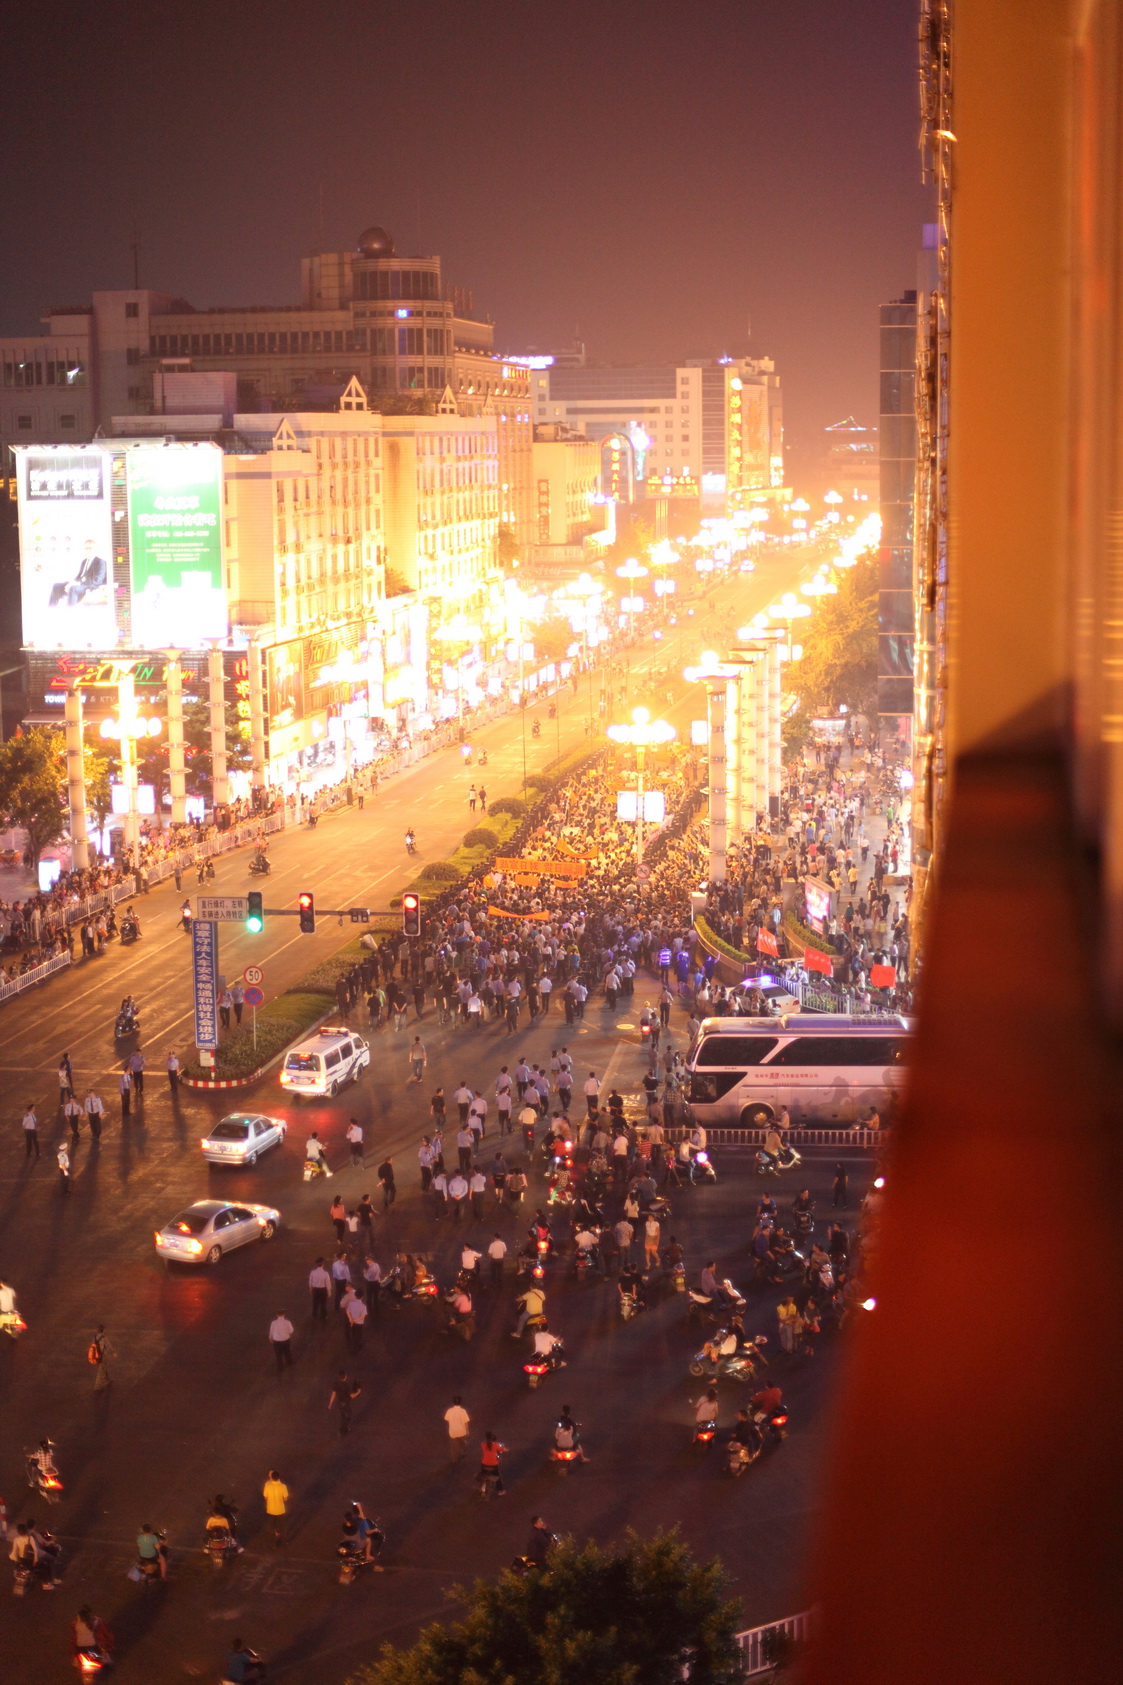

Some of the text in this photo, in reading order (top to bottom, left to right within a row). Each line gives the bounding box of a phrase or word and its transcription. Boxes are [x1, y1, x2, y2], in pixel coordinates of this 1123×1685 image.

[201, 910, 243, 920] 车辆进入待转区
[248, 970, 260, 982] 50
